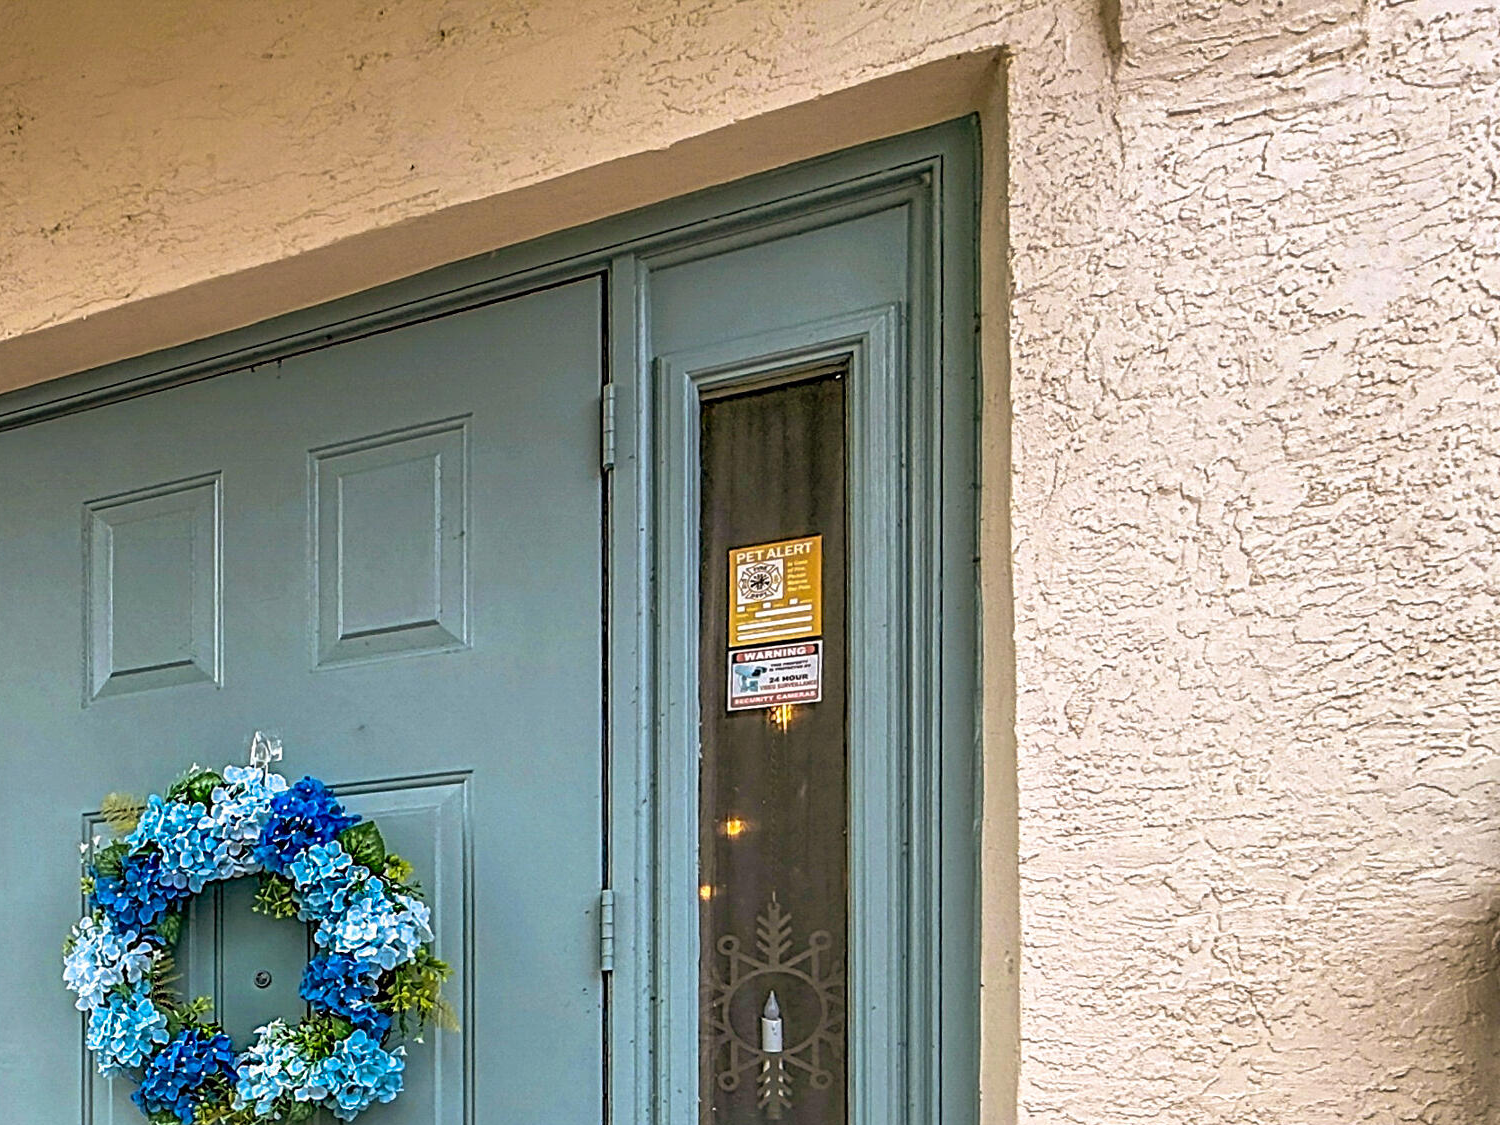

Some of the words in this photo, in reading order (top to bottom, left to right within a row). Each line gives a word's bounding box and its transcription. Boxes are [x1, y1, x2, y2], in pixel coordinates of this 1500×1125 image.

[736, 550, 766, 564] PET
[766, 542, 813, 559] ALERT
[744, 646, 807, 661] WARNING
[777, 679, 817, 690] SURVEILLANCE
[782, 673, 809, 682] HOUR
[734, 694, 774, 705] SECURITY
[776, 690, 816, 700] CAMERAS
